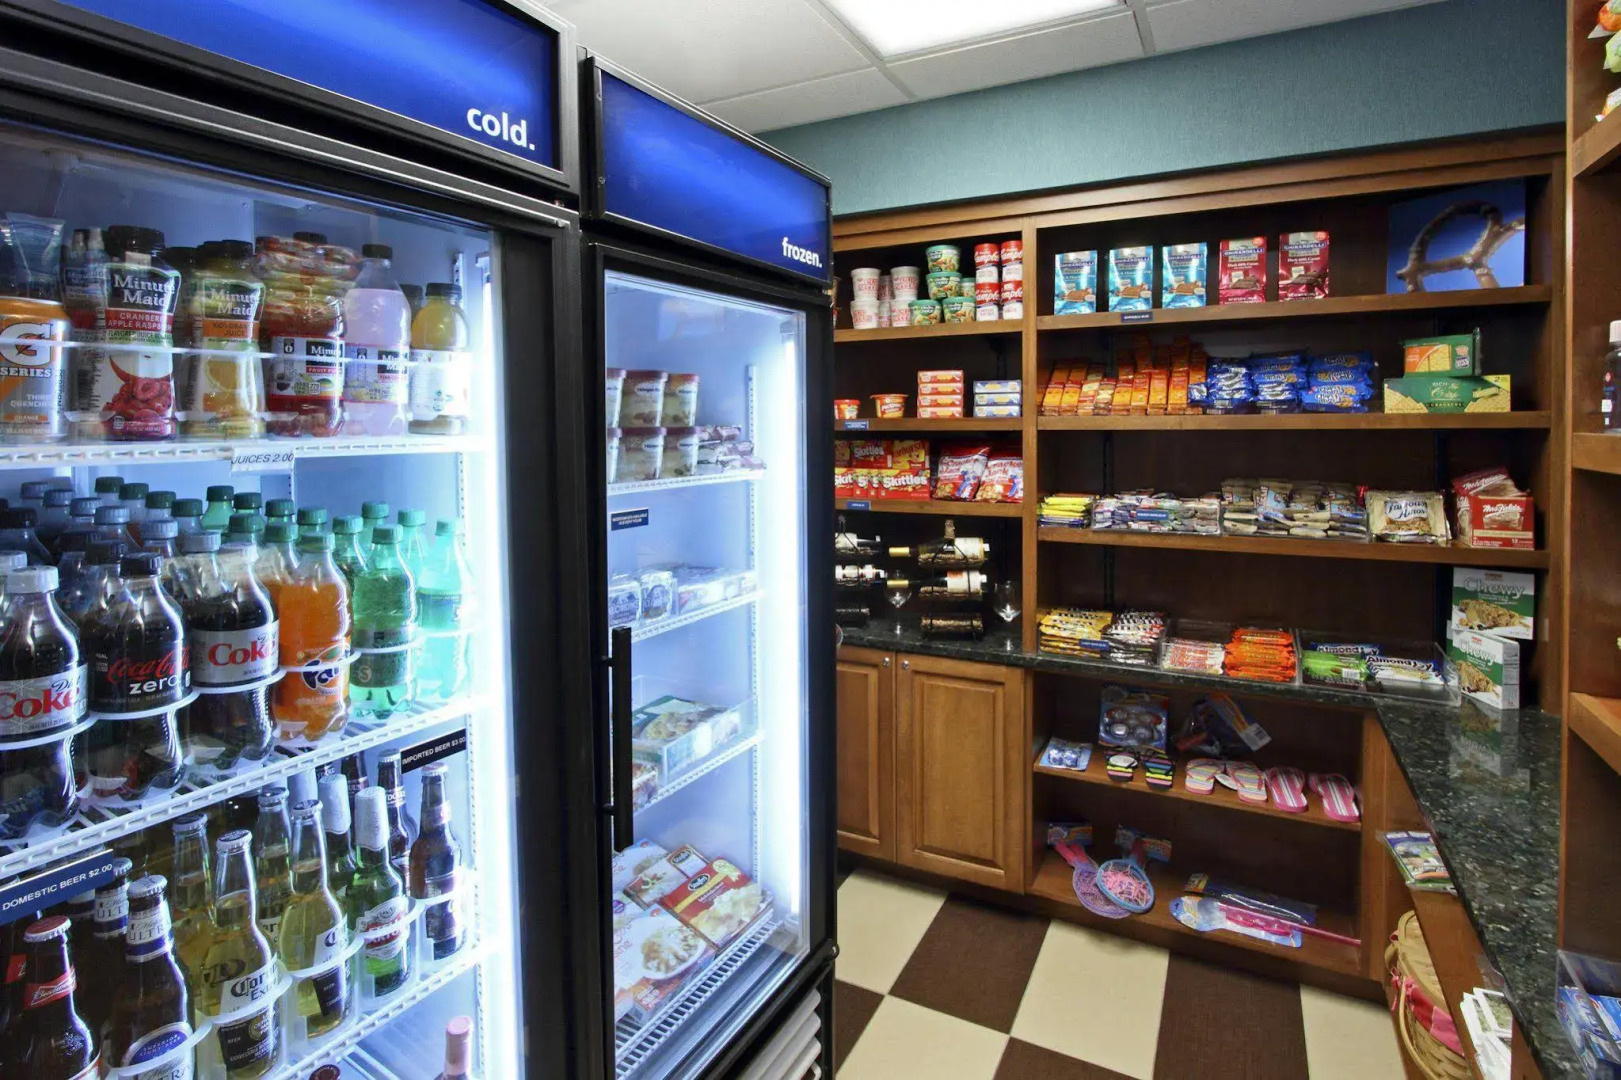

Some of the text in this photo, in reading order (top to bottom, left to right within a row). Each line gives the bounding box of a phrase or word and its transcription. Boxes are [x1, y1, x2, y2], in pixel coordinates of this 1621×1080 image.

[466, 104, 536, 151] cold.
[781, 236, 823, 269] frozen.
[0, 366, 52, 378] SERIES
[231, 453, 295, 465] JUICES 2.00
[854, 445, 884, 458] Skittles
[835, 474, 853, 486] Skit
[883, 474, 928, 488] Skittles
[1464, 576, 1525, 599] Chewy
[1367, 656, 1413, 666] Almond
[1459, 638, 1497, 666] Chewy
[129, 674, 180, 695] zero
[402, 748, 434, 765] IMPORTED
[434, 742, 451, 753] BEER
[2, 863, 113, 911] DOMESTIC BEER $2.00
[130, 925, 164, 940] ULTR
